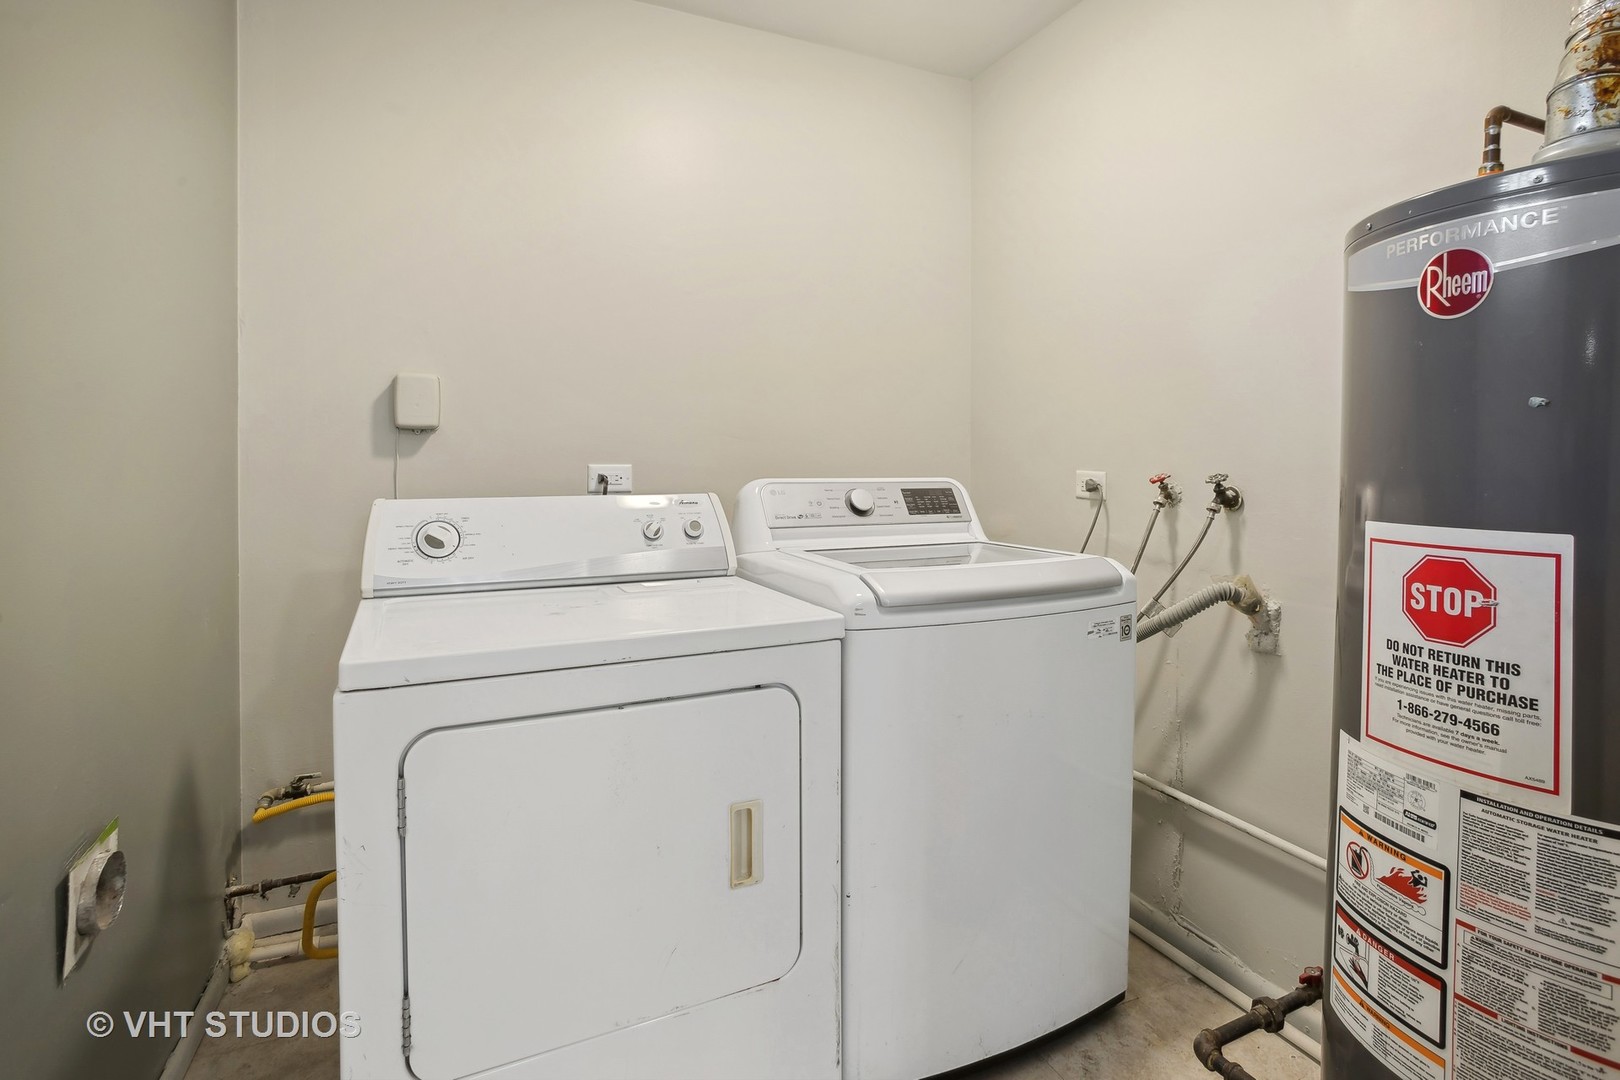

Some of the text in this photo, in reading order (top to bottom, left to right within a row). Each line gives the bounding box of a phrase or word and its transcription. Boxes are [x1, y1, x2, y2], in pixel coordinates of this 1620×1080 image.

[1386, 206, 1560, 259] PERFORMANCE
[1426, 252, 1488, 308] Rheem
[1410, 582, 1483, 618] STOP
[1386, 638, 1521, 677] DO NOT RETURN THIS
[1392, 653, 1510, 690] WATER HEATER TO
[1376, 663, 1539, 711] THE PLACE OF PURCHASE
[1397, 699, 1500, 736] 1-866-279-4566
[1450, 704, 1471, 713] general
[1472, 709, 1501, 719] questions
[1497, 708, 1521, 718] missing
[1406, 728, 1426, 739] provided
[1437, 738, 1449, 746] your
[1449, 742, 1465, 750] water
[1432, 724, 1454, 734] available
[1460, 732, 1475, 740] days
[1451, 735, 1460, 743] the
[1484, 744, 1507, 754] manual
[1476, 797, 1604, 835] INSTALLATION AND OPERATION DETAILS
[1481, 808, 1598, 844] AUTOMATIC STORAGE WATER HEATER
[1366, 834, 1407, 862] WARNING
[1363, 934, 1395, 961] DANGER
[1503, 940, 1524, 951] SAFETY
[1540, 954, 1563, 966] BEFORE
[1564, 962, 1598, 978] OPERATING
